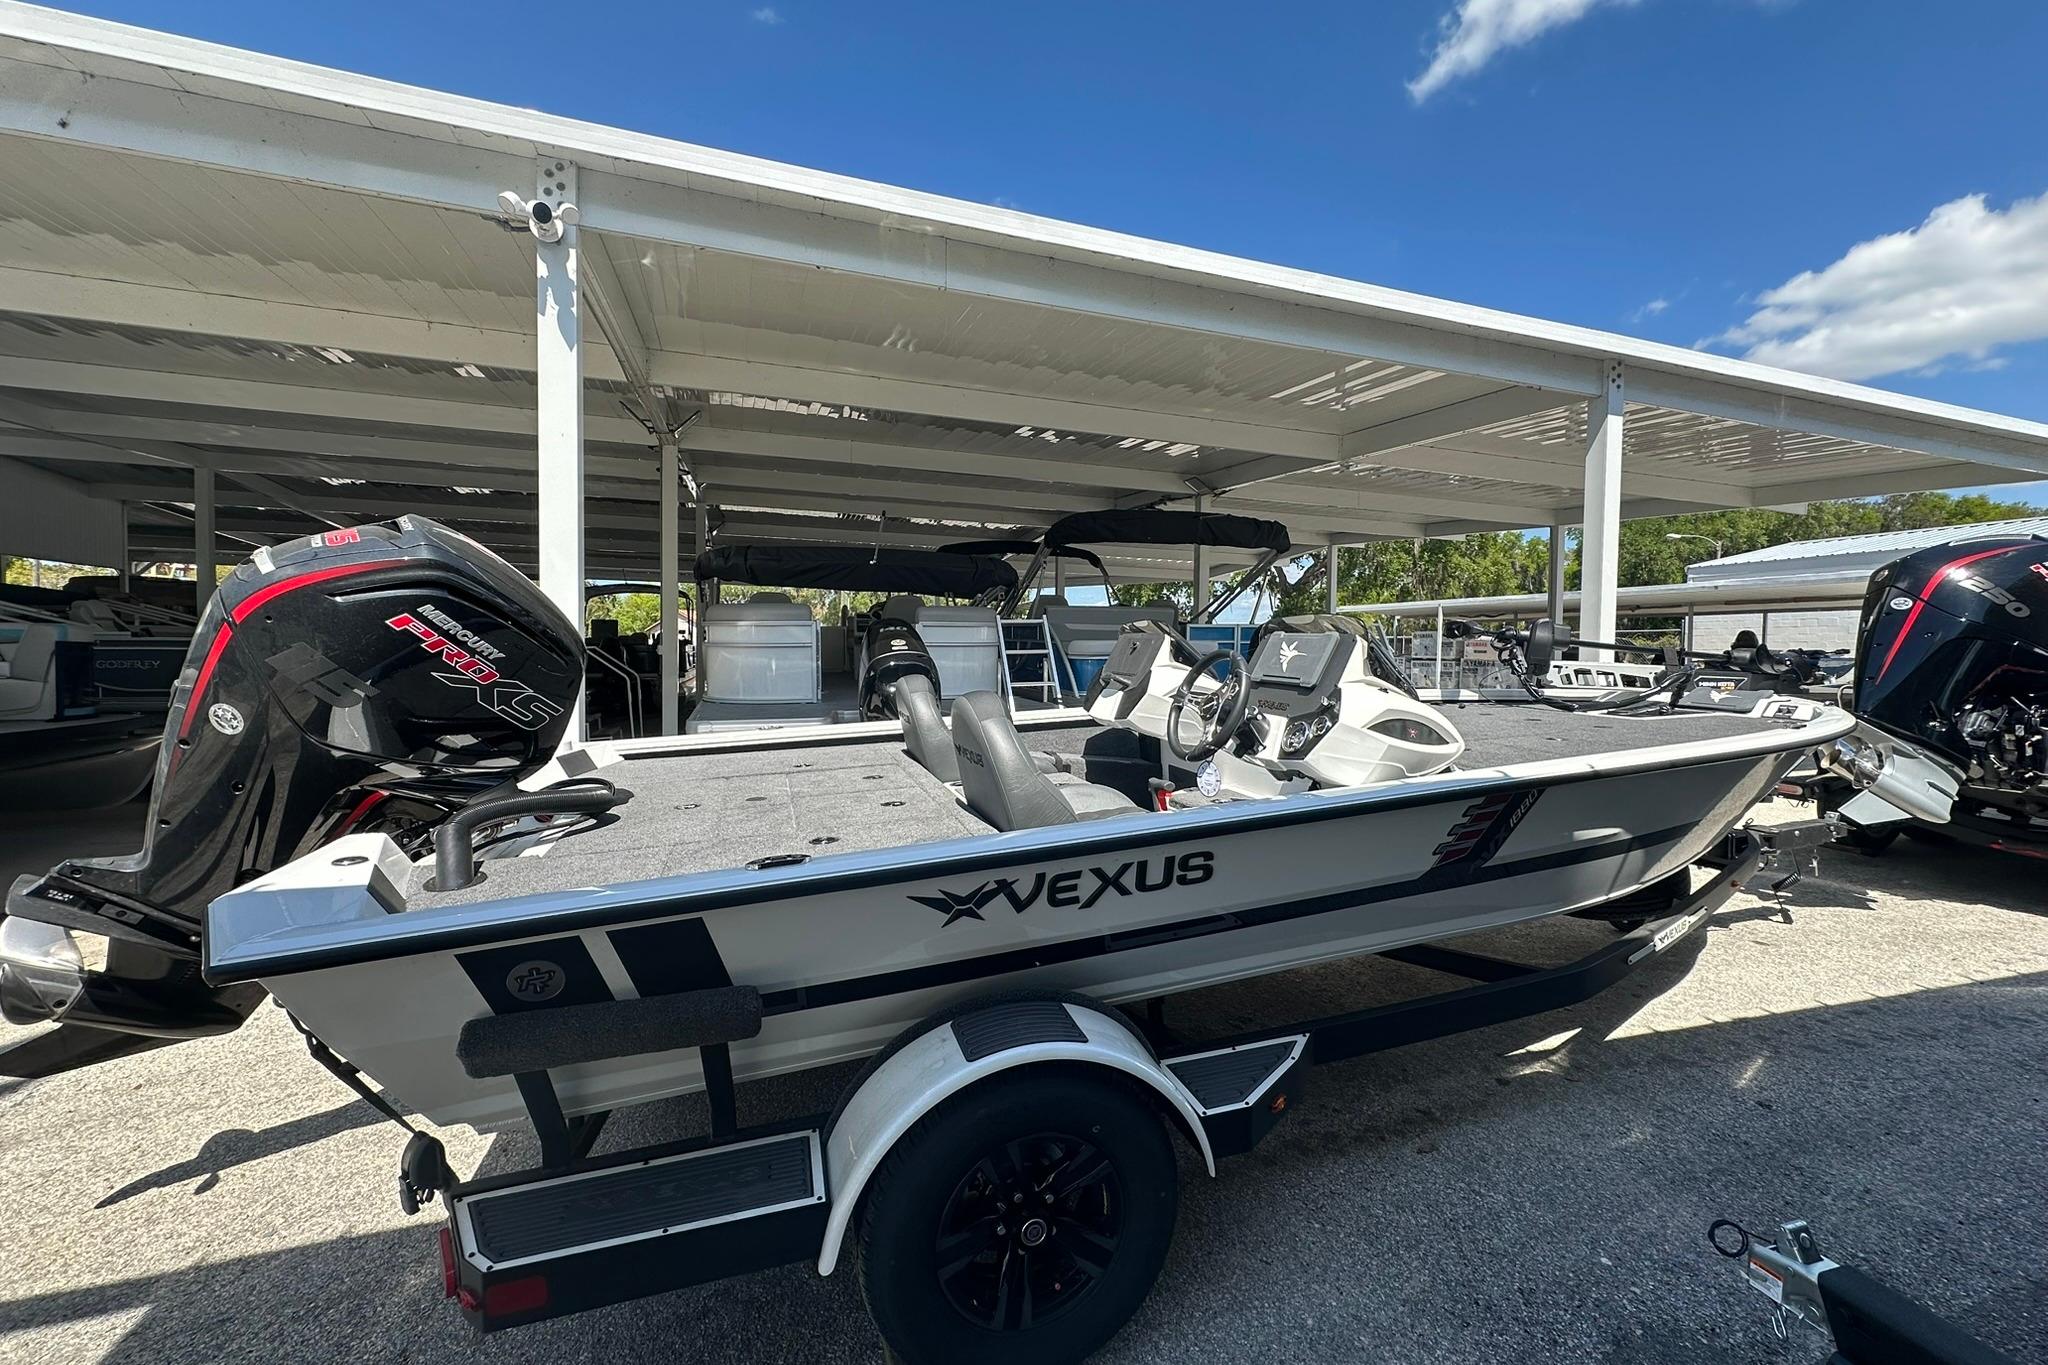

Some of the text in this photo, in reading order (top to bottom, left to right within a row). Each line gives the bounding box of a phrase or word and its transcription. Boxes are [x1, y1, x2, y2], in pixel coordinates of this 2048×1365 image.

[1957, 576, 2031, 618] 250
[417, 604, 506, 661] MERCURY
[96, 660, 160, 670] GODFREY
[385, 613, 565, 730] PRO XS
[1509, 789, 1538, 827] 1880
[993, 851, 1214, 915] VEXUS
